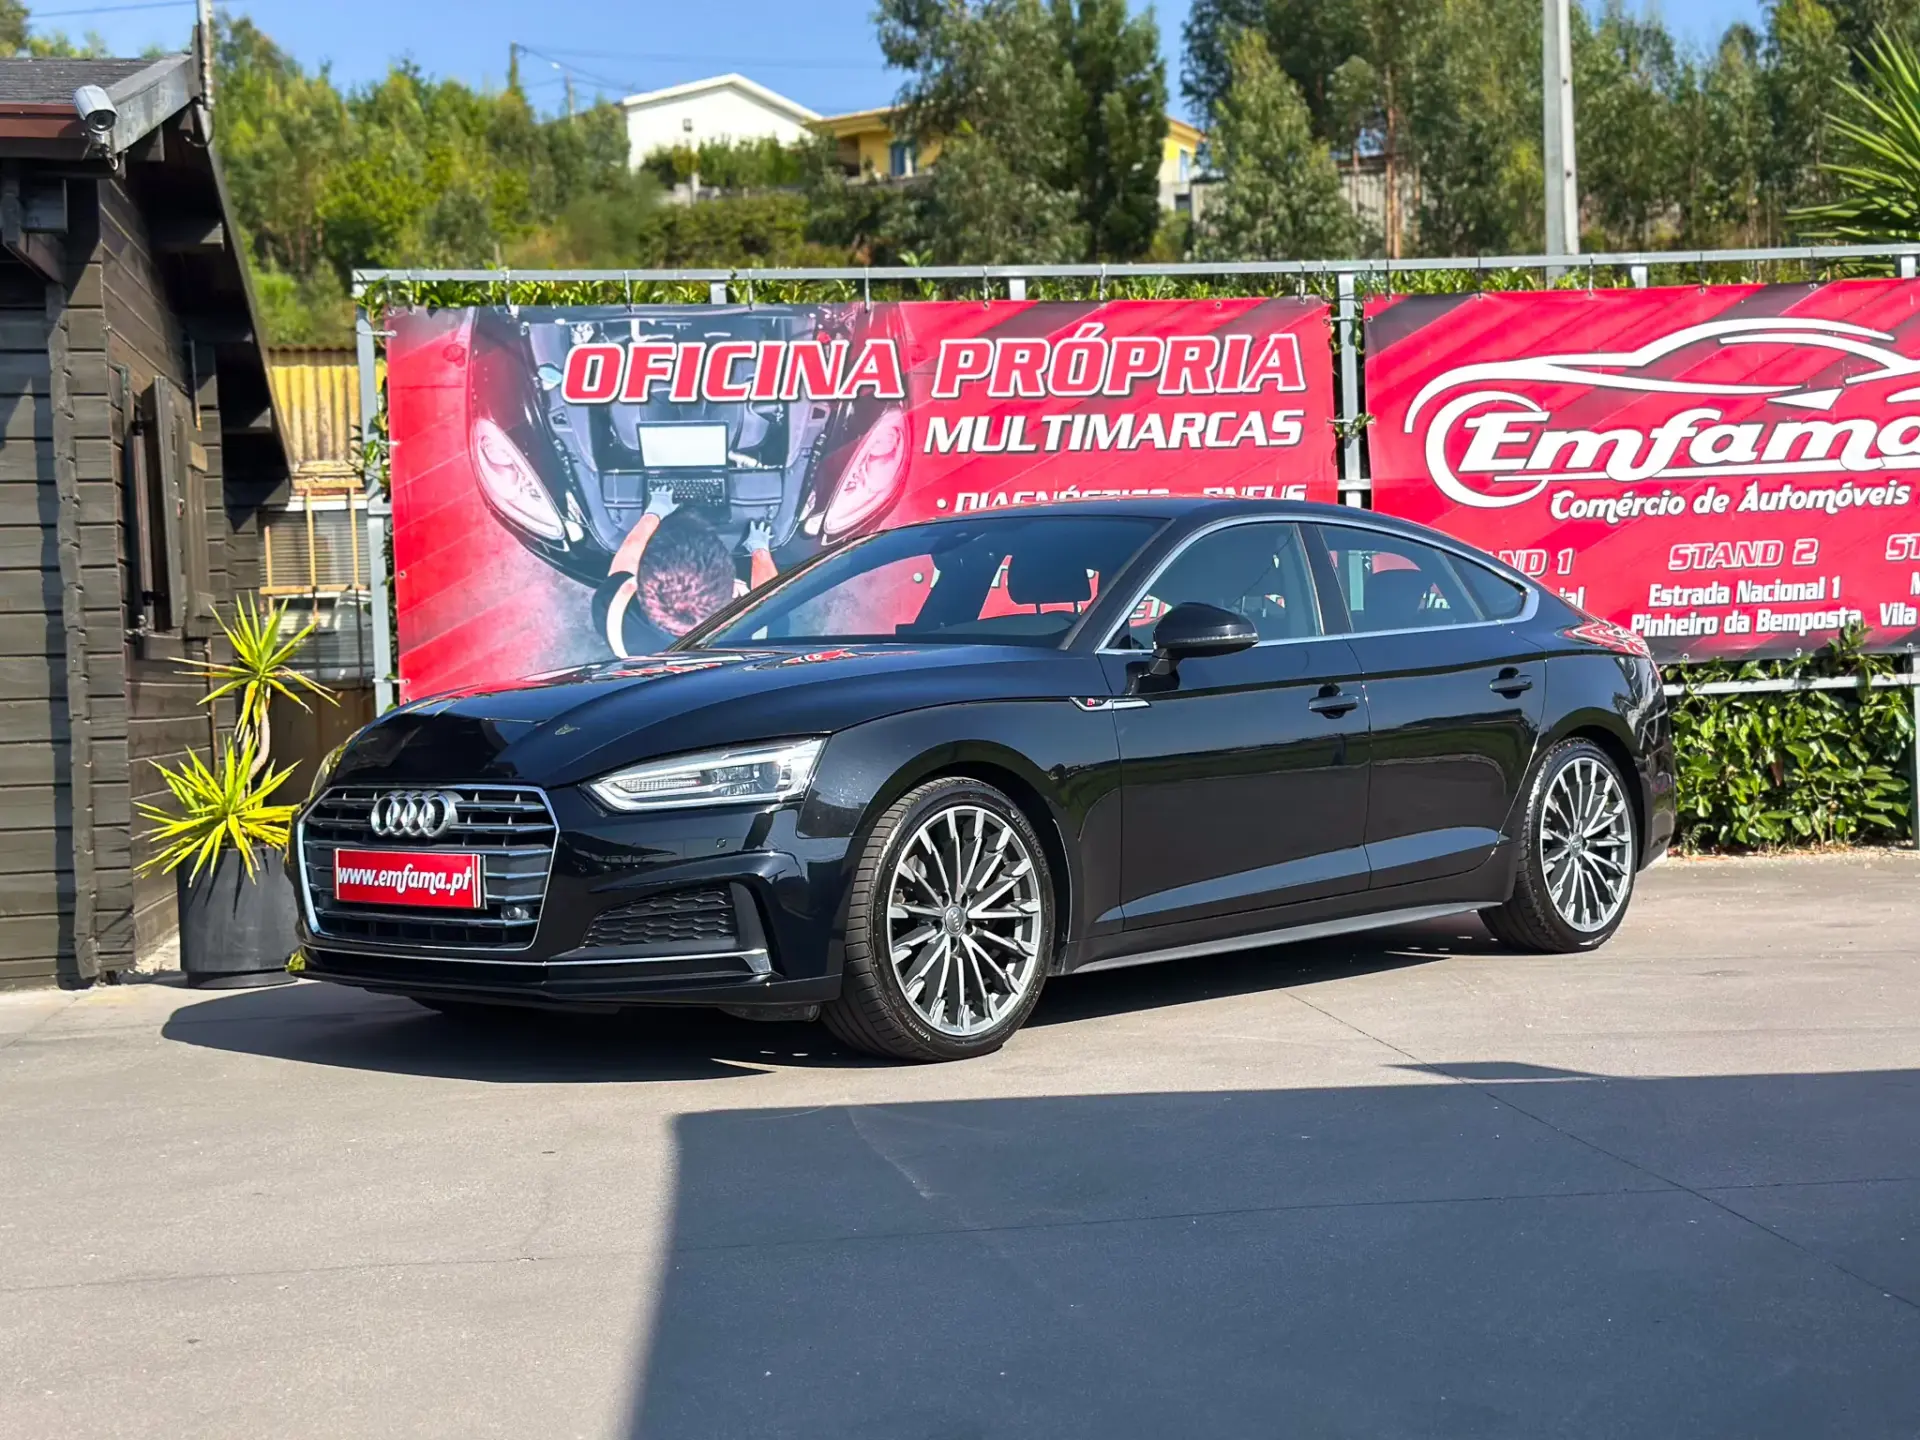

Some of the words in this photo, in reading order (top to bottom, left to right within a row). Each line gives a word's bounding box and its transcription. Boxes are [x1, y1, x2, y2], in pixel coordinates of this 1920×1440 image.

[561, 339, 905, 402] OFICINA
[931, 323, 1306, 398] PRÓPRIA
[923, 410, 1304, 453] MULTIMARCAS
[1457, 407, 1920, 482] Emfama
[1551, 489, 1685, 523] Comércio
[1692, 483, 1729, 515] de
[1557, 548, 1573, 575] 1
[1668, 540, 1784, 571] STAND
[1793, 538, 1820, 566] 2
[1648, 579, 1729, 607] Estrada
[1735, 575, 1825, 604] Nacional
[1832, 575, 1841, 600] 1
[1631, 610, 1719, 638] Pinheiro
[1723, 608, 1750, 634] da
[1756, 606, 1862, 635] Bemposta
[1879, 602, 1917, 627] Vila
[338, 863, 472, 896] www.emfama.pt
